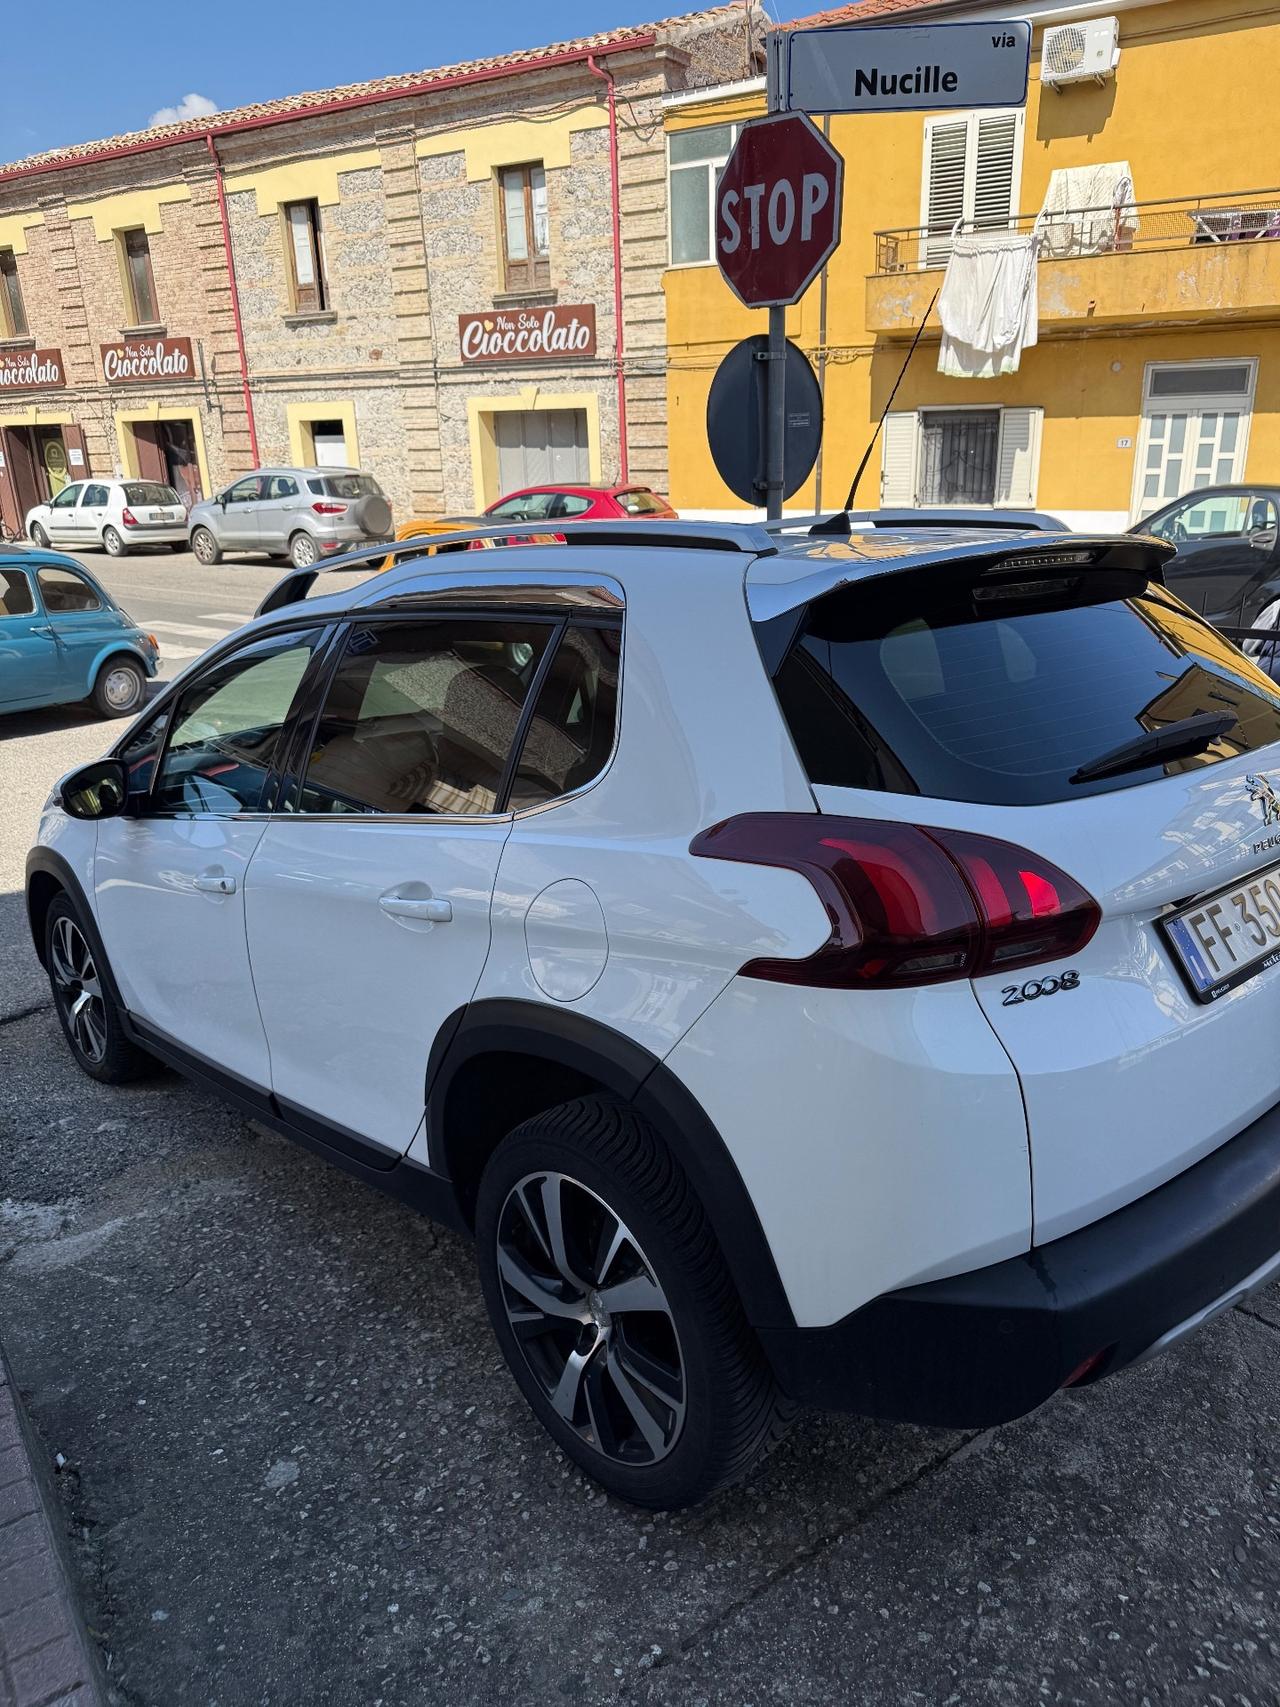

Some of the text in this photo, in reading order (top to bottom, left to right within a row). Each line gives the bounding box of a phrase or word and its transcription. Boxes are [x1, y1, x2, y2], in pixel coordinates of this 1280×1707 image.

[991, 33, 1016, 48] via
[854, 66, 958, 97] Nucille
[720, 172, 830, 254] STOP
[462, 310, 590, 359] Cioccolato
[496, 313, 540, 331] Non Solo
[104, 342, 188, 380] Cioccolato
[1121, 439, 1129, 447] 17
[1189, 904, 1238, 972] FF
[1001, 969, 1081, 1007] 2008
